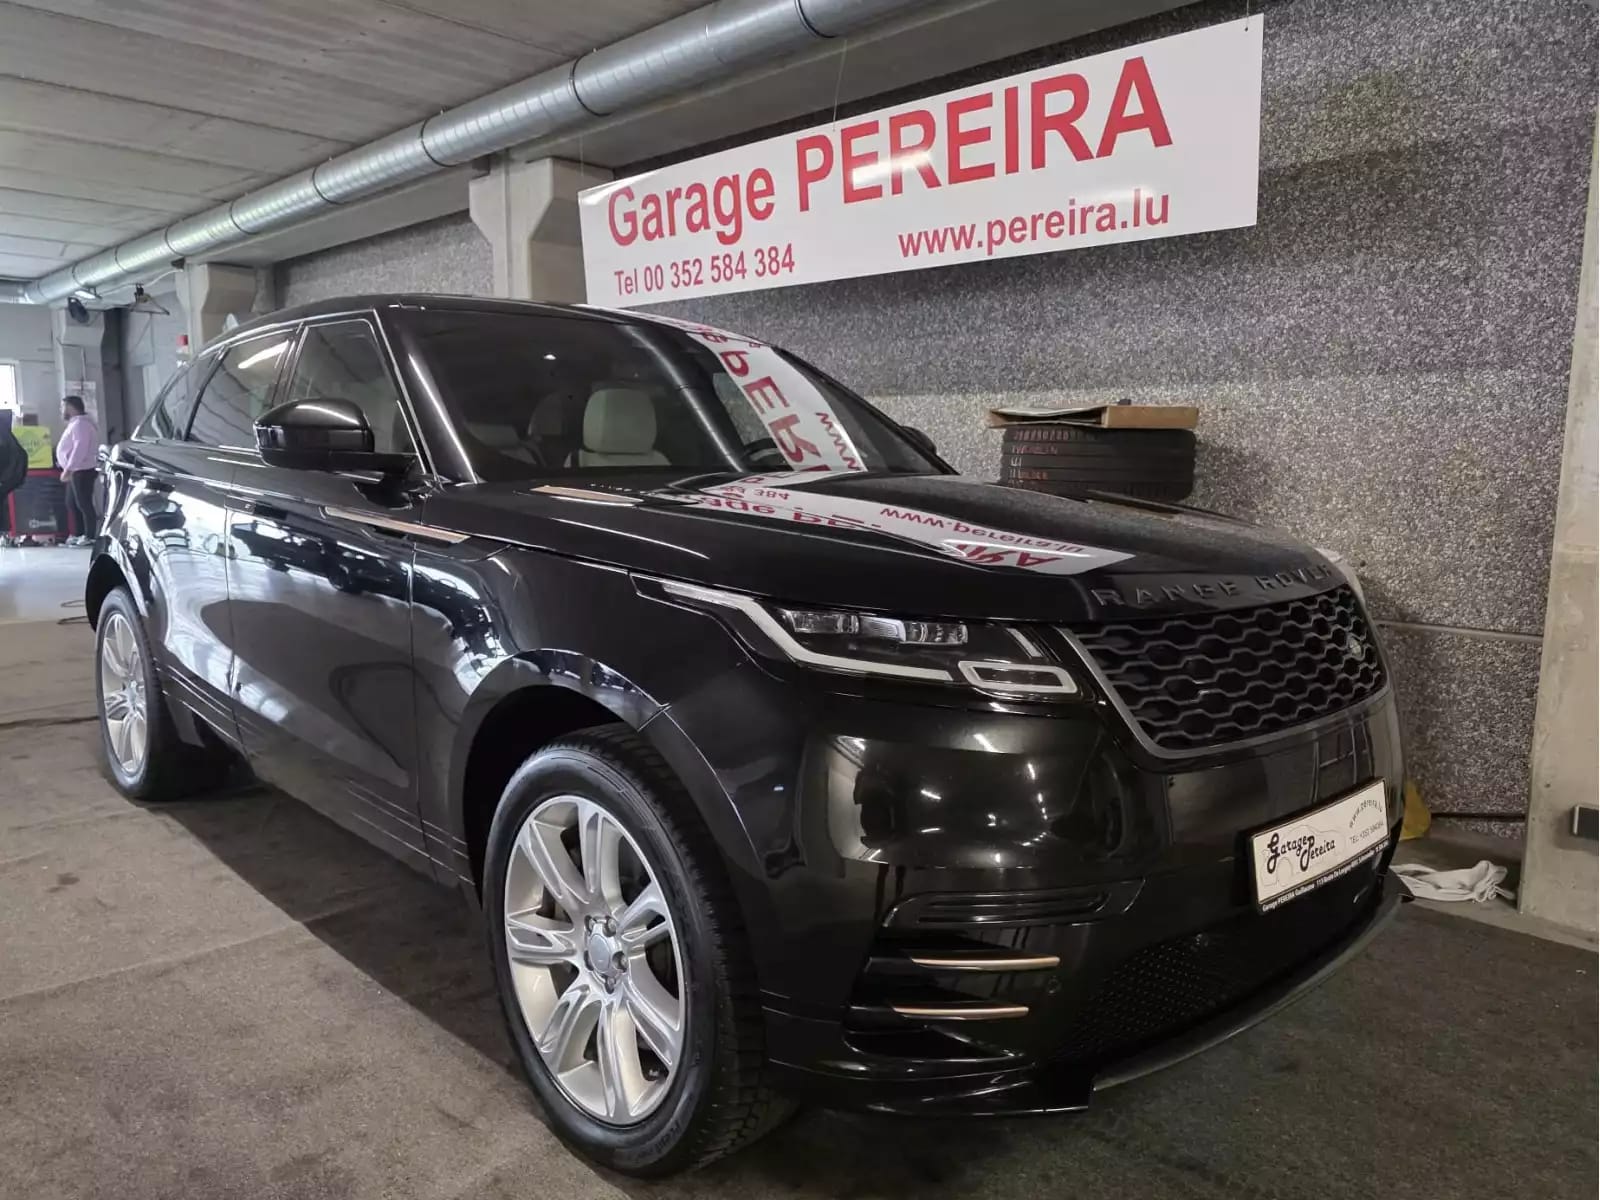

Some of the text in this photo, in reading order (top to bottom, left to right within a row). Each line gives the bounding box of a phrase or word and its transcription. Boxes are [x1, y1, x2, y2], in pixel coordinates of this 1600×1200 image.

[608, 56, 1174, 248] Garage PEREIRA
[898, 190, 1171, 257] www.pereira.lu
[614, 243, 796, 297] Tel 00 352 584 384
[1091, 563, 1333, 607] RANGE ROVER
[1266, 832, 1308, 874] Garage
[1300, 835, 1336, 872] Pereira
